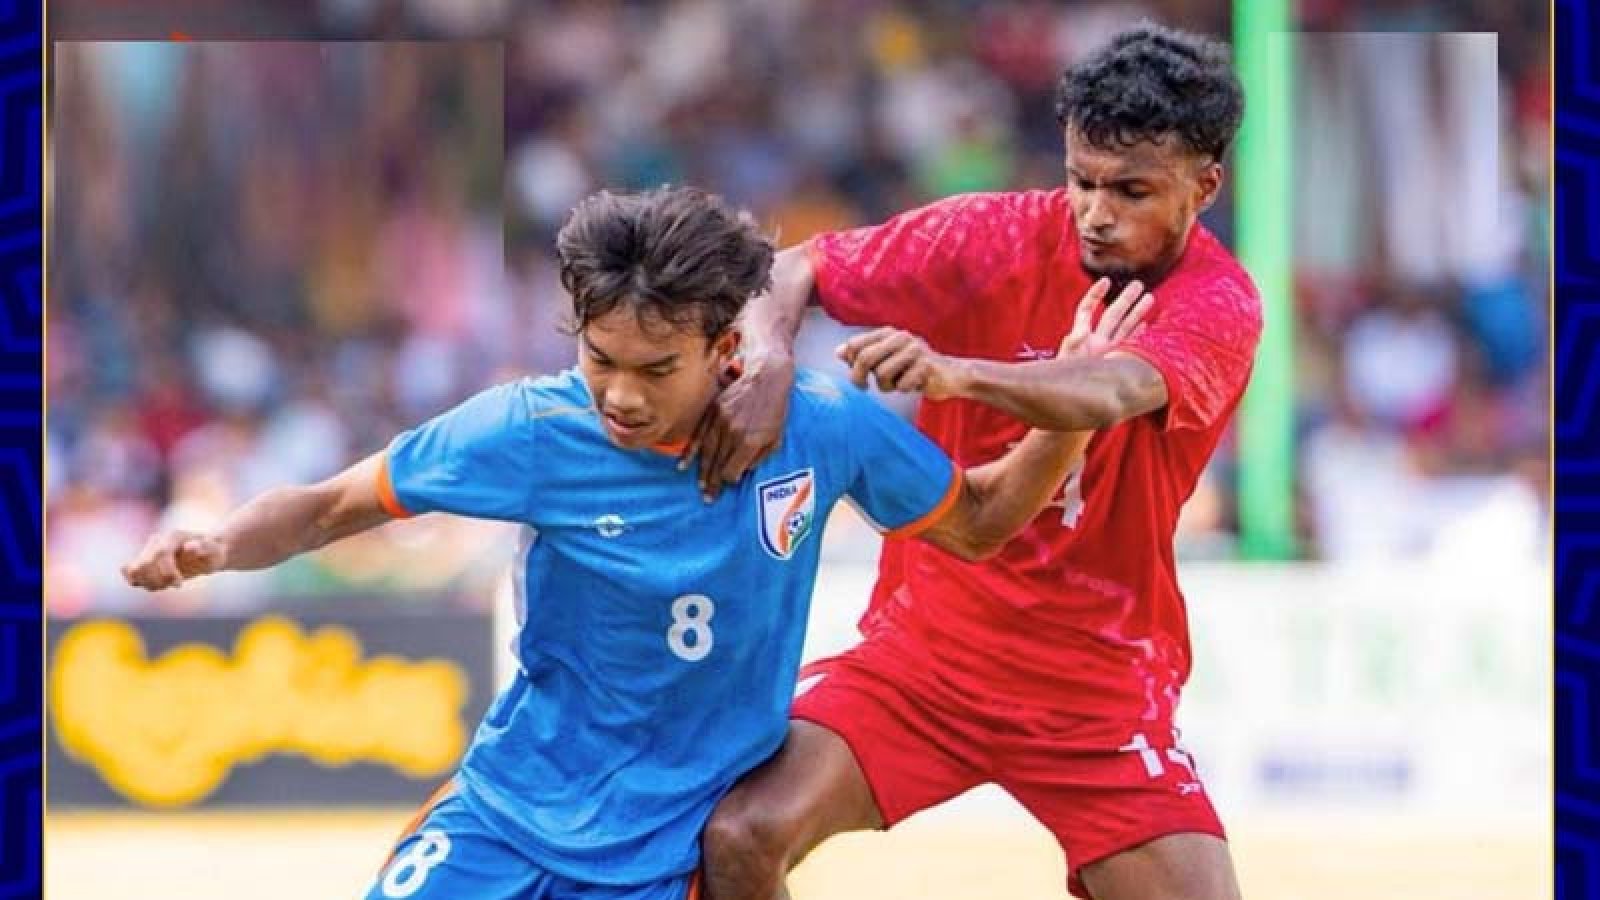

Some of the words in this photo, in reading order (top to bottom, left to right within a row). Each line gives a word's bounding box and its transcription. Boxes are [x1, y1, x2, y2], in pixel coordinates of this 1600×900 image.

[766, 484, 799, 502] INDIA
[667, 593, 715, 663] 8
[381, 830, 453, 899] 8
